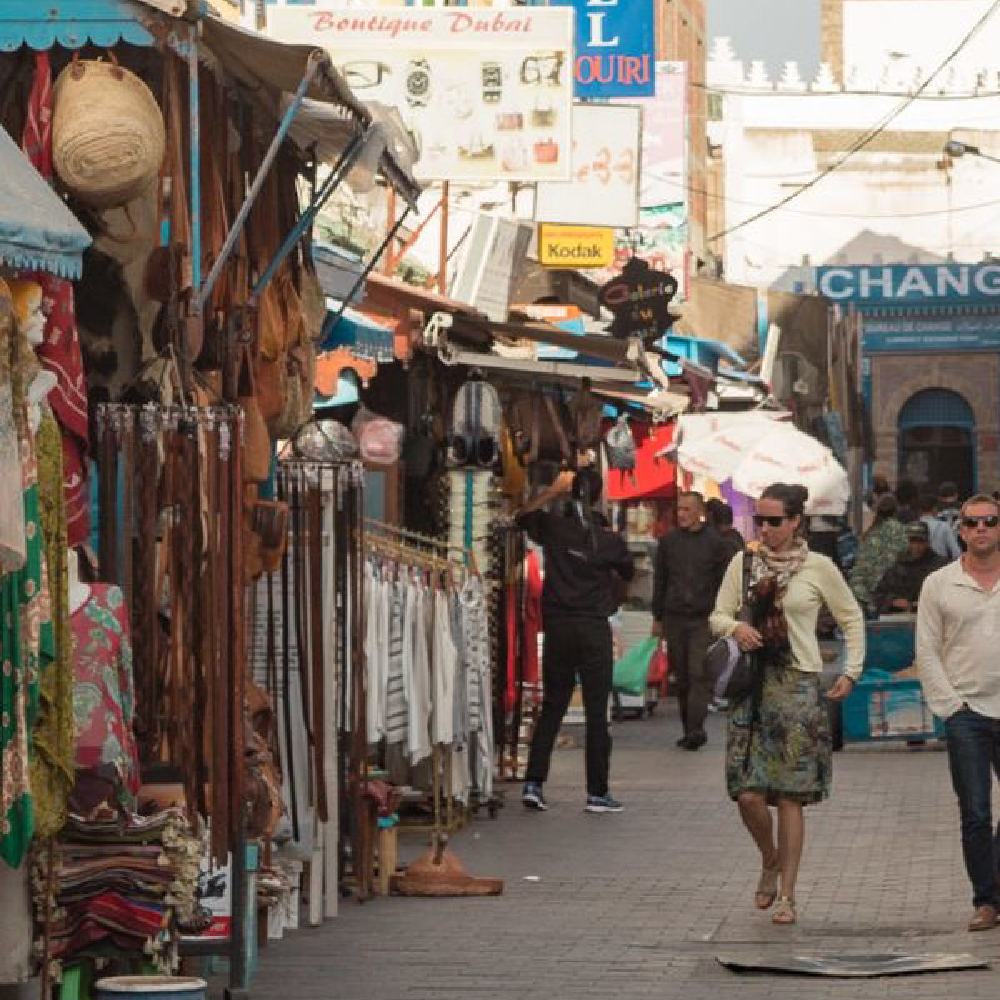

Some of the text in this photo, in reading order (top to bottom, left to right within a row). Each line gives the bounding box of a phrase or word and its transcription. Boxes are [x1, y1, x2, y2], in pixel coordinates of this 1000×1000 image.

[308, 11, 533, 37] Boutique Dubai
[575, 55, 651, 84] OUIRI
[547, 244, 603, 258] Kodak
